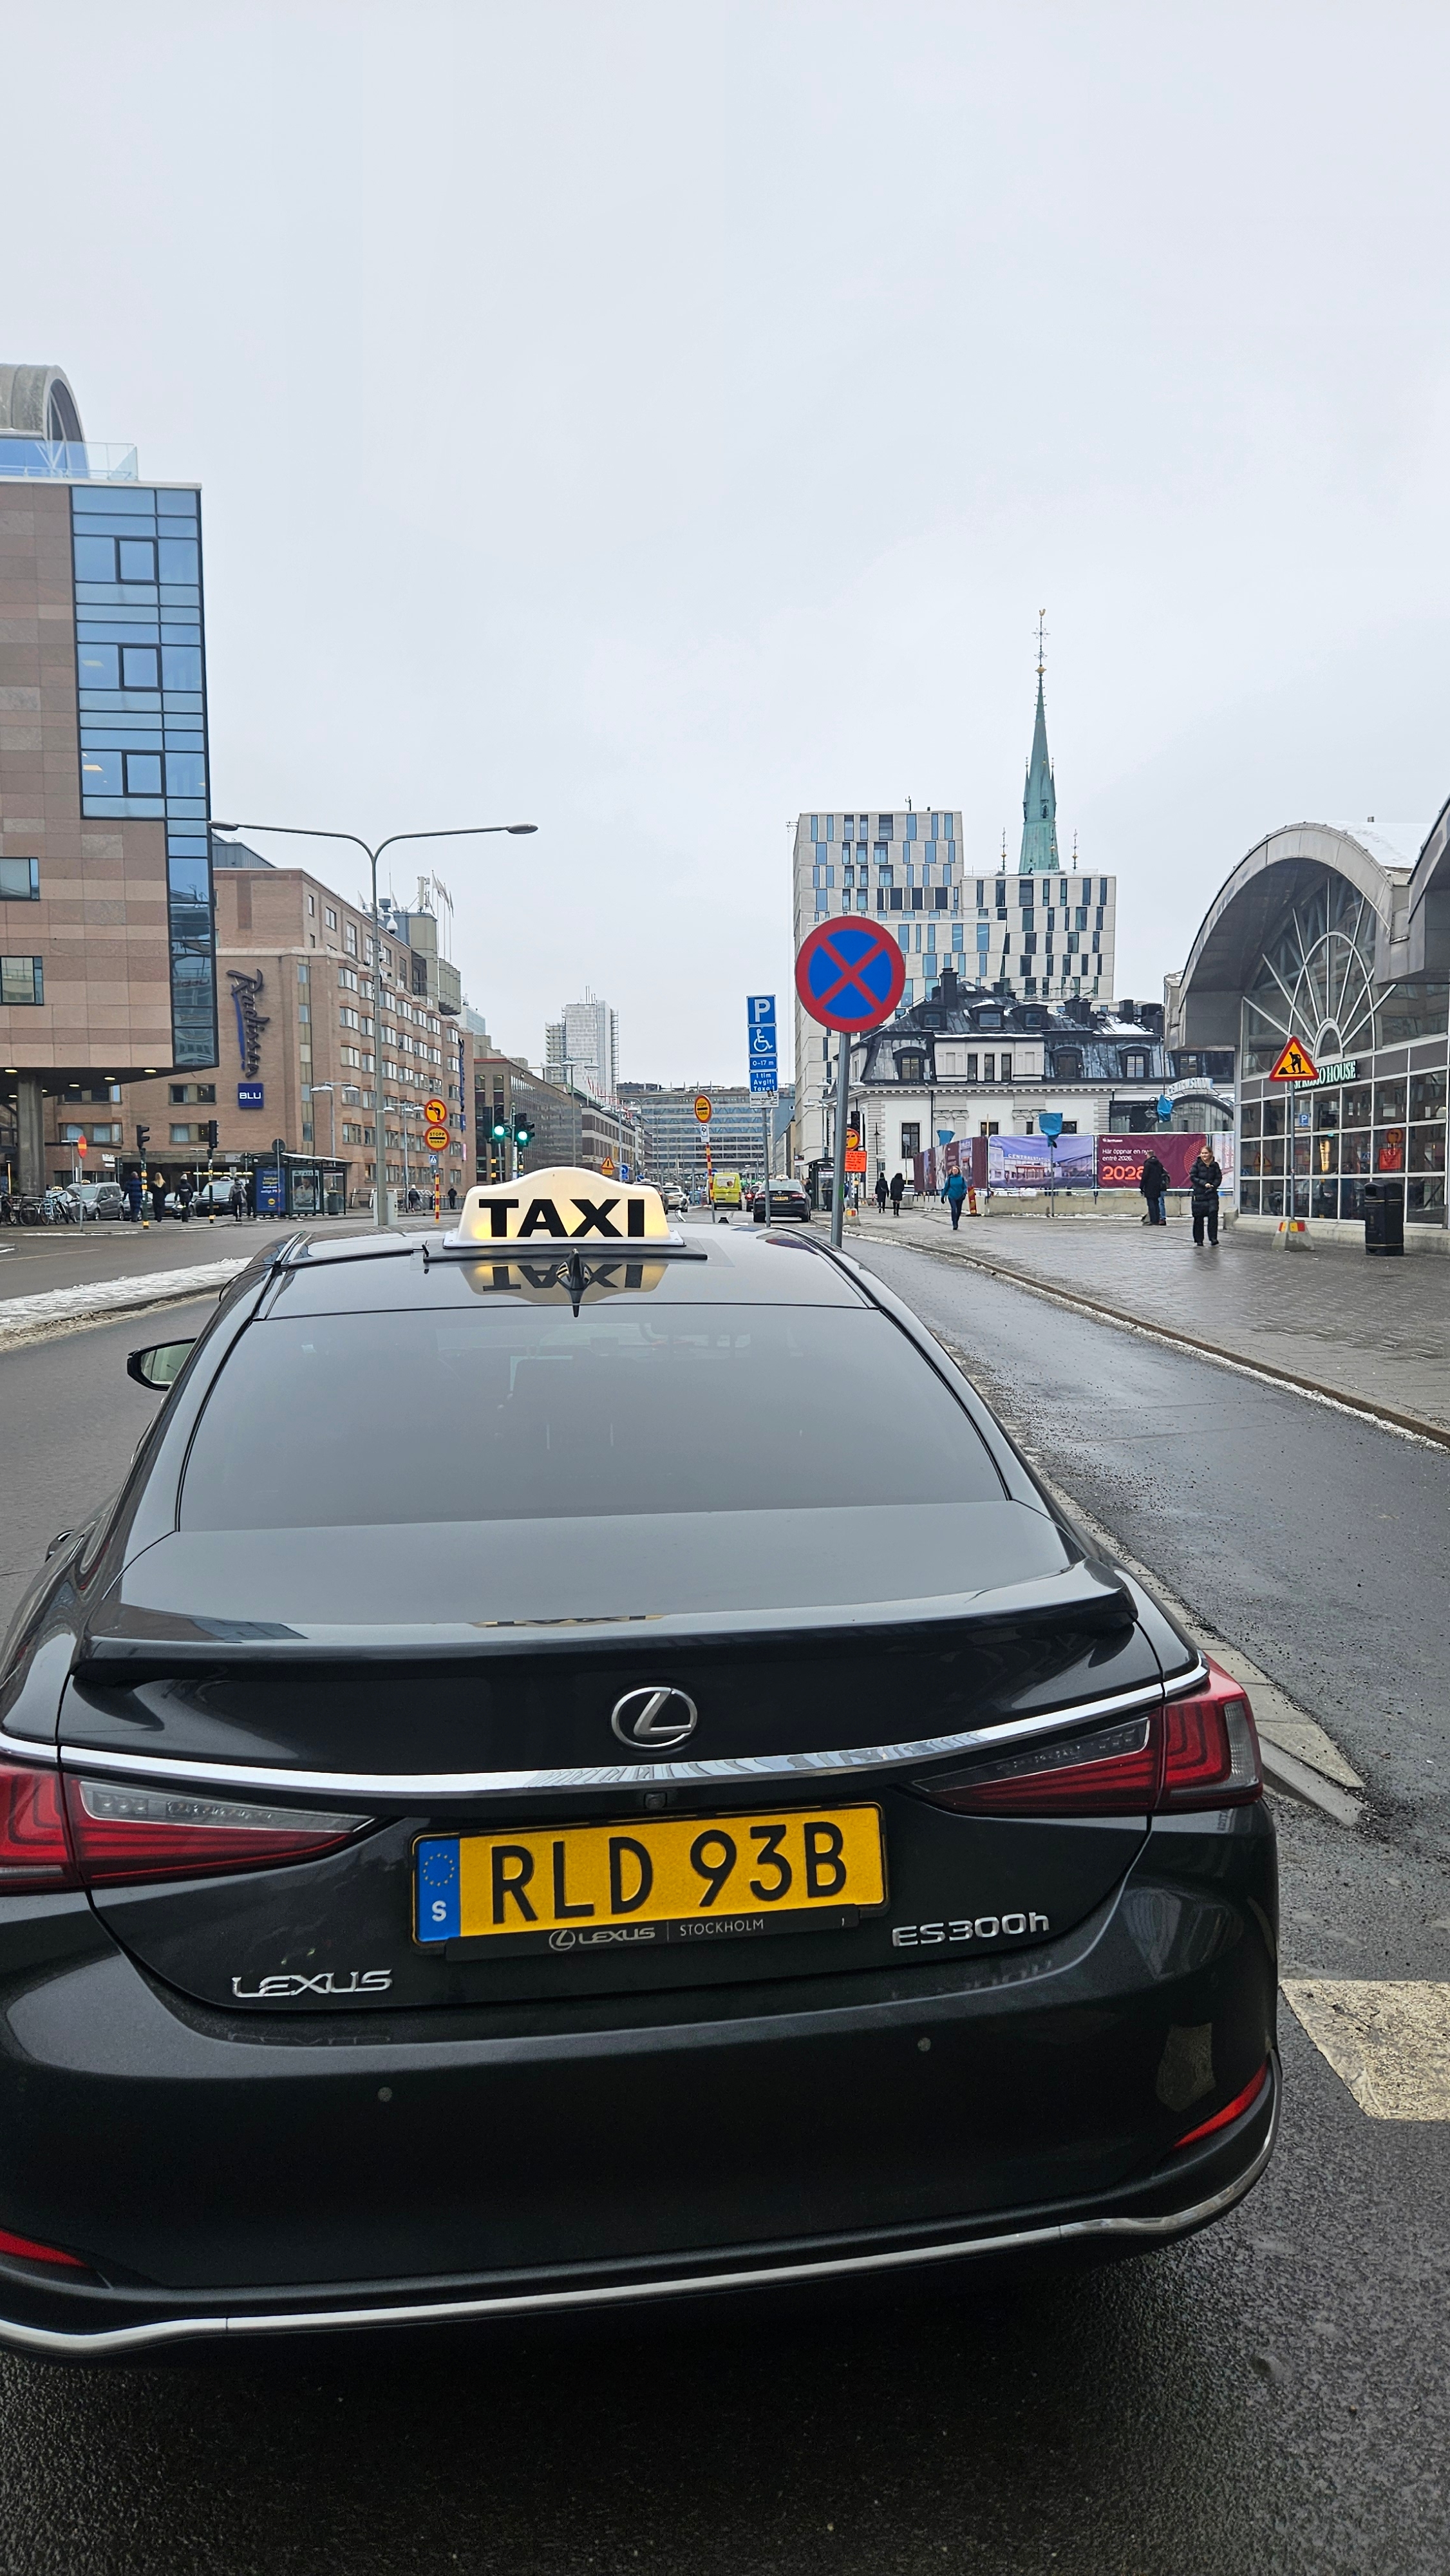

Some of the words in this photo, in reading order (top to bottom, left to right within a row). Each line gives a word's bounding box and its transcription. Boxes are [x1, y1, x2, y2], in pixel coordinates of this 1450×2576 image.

[225, 969, 270, 1078] Radisson
[755, 998, 771, 1022] P
[1327, 1060, 1356, 1083] HOUSE
[479, 1198, 645, 1237] TAXI
[490, 1837, 653, 1924] RLD
[690, 1822, 847, 1908] 93B
[431, 1900, 447, 1922] S
[579, 1927, 655, 1944] LEXUS
[680, 1919, 764, 1937] STOCKHOLM
[892, 1912, 1050, 1947] ES300h
[232, 1969, 393, 1998] LEXUS
